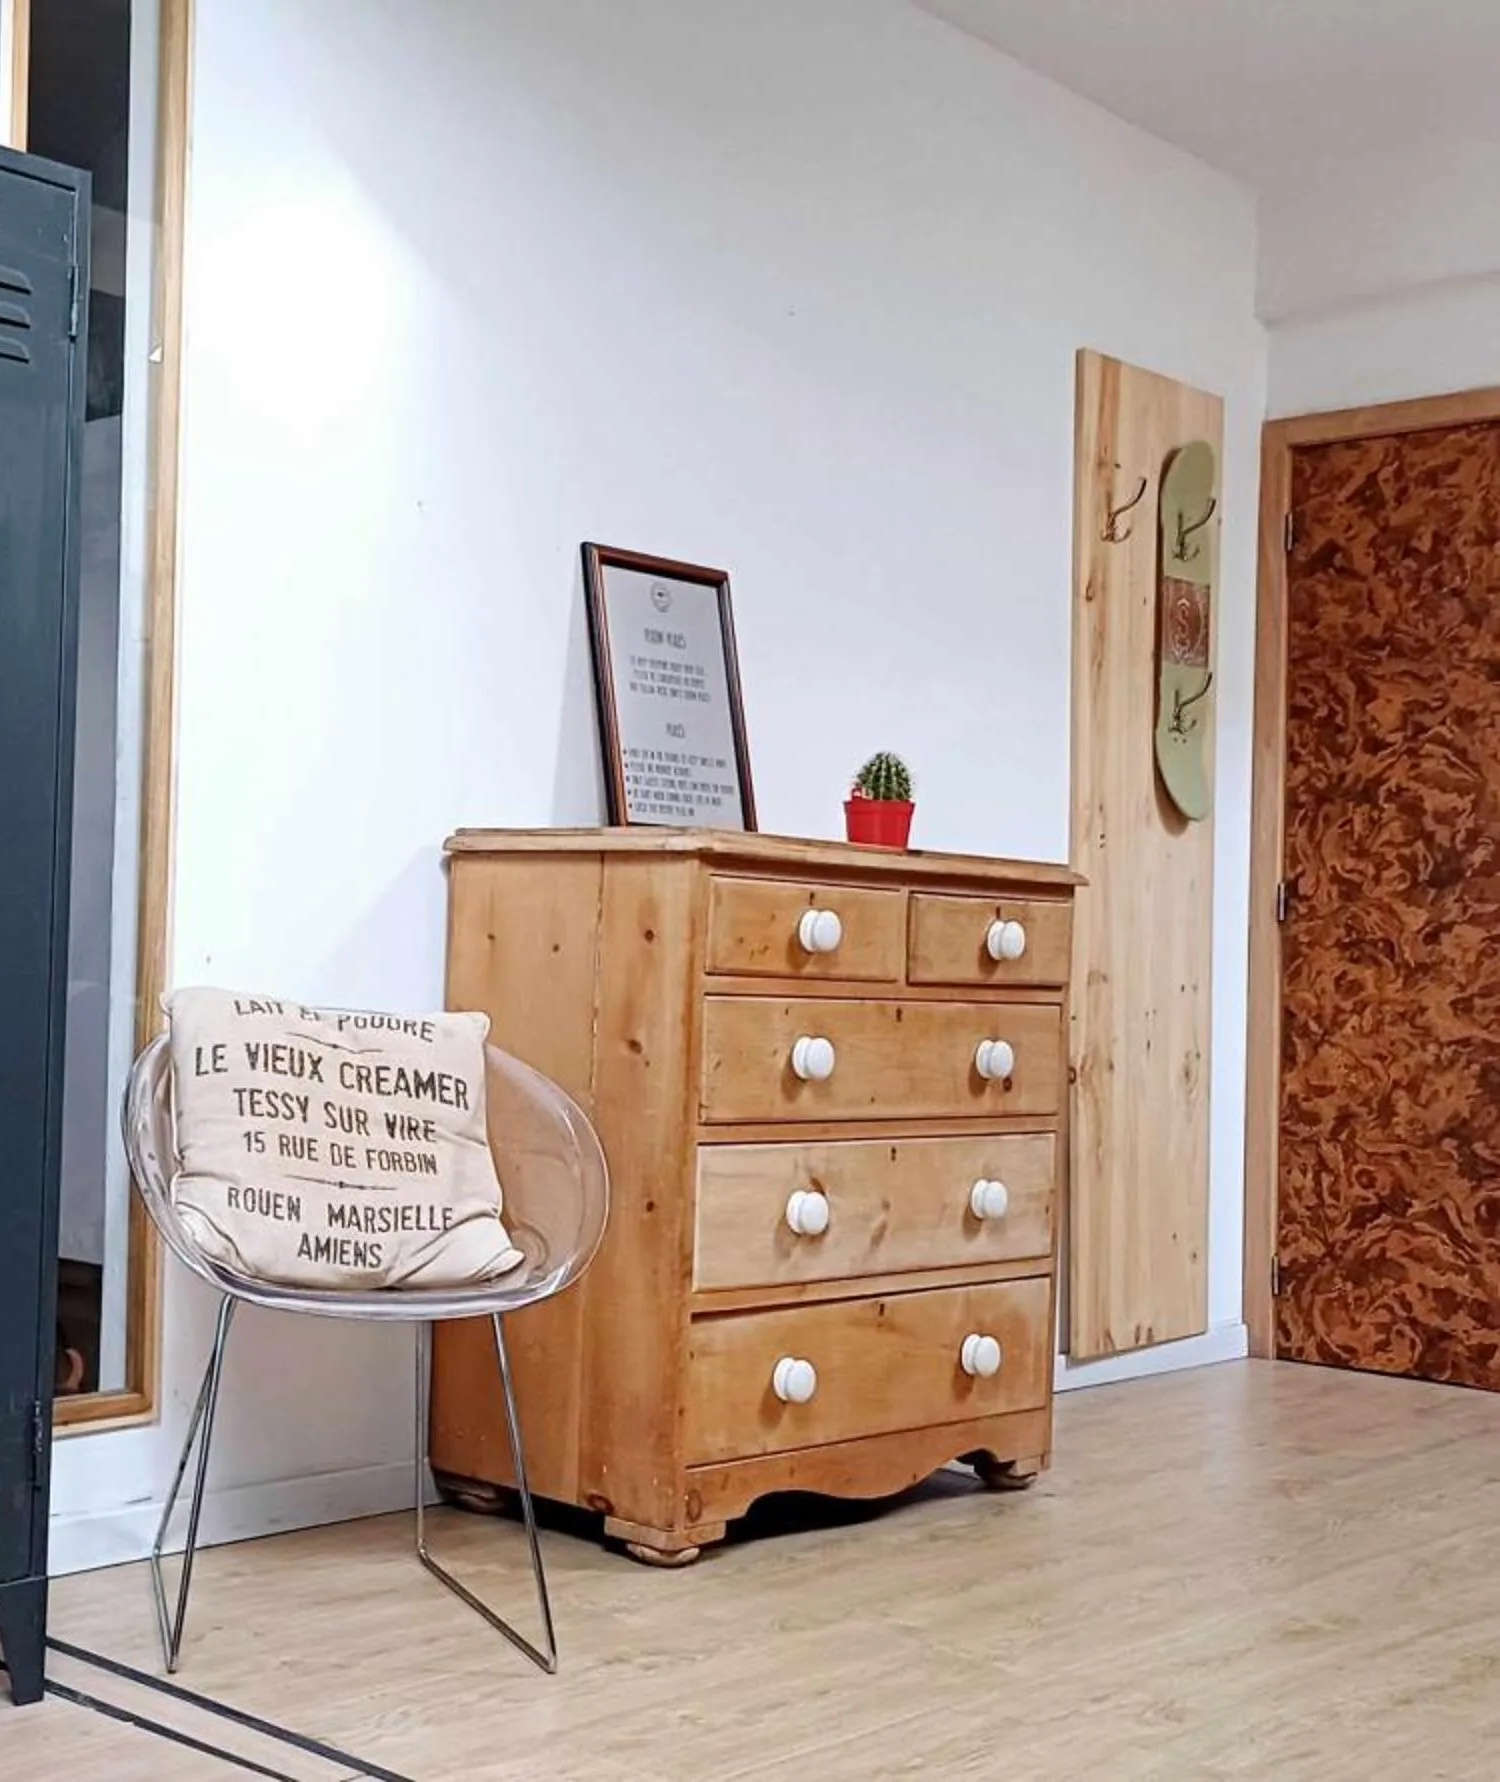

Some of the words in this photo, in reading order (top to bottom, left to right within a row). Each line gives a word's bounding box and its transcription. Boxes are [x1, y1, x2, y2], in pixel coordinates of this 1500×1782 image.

[234, 999, 284, 1016] LAIT
[195, 1043, 228, 1077] LE
[245, 1042, 324, 1083] VIEUX
[339, 1061, 469, 1111] CREAMER
[233, 1087, 309, 1124] TESSY
[324, 1101, 370, 1136] SUR
[384, 1112, 437, 1143] VIRE
[243, 1131, 265, 1154] 15
[279, 1133, 319, 1162] RUE
[330, 1143, 357, 1169] DE
[366, 1149, 437, 1175] FORBIN
[227, 1186, 301, 1223] ROUEN
[327, 1203, 453, 1235] MARSIELLE
[296, 1232, 383, 1270] AMIENS
